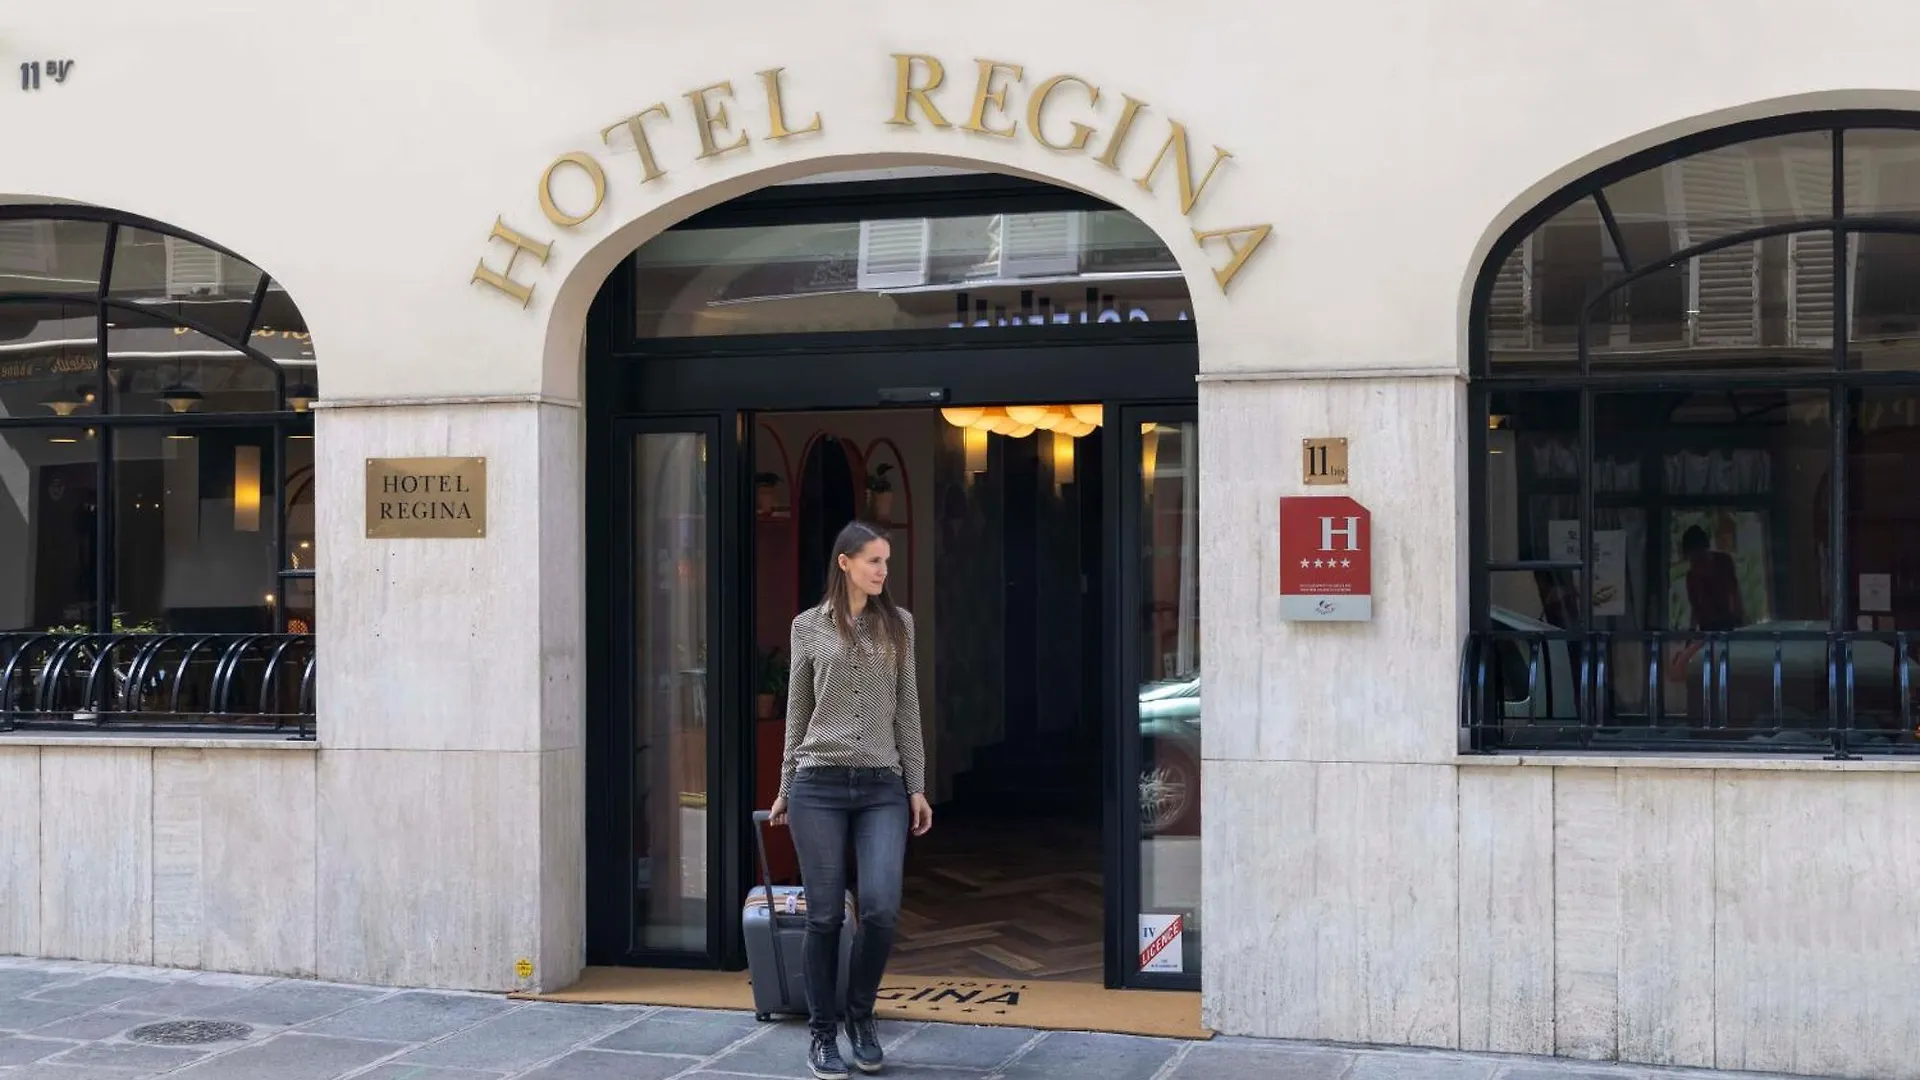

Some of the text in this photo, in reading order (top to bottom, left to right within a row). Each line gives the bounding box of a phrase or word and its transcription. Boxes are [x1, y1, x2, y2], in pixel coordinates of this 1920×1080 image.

[471, 53, 1273, 310] HOTEL REGINA
[1305, 445, 1328, 476] 11
[383, 475, 470, 493] HOTEL
[380, 501, 472, 519] REGINA
[1317, 516, 1361, 551] H
[1142, 920, 1180, 965] LICENCE
[1143, 927, 1156, 938] IV
[876, 987, 1020, 1006] GINA
